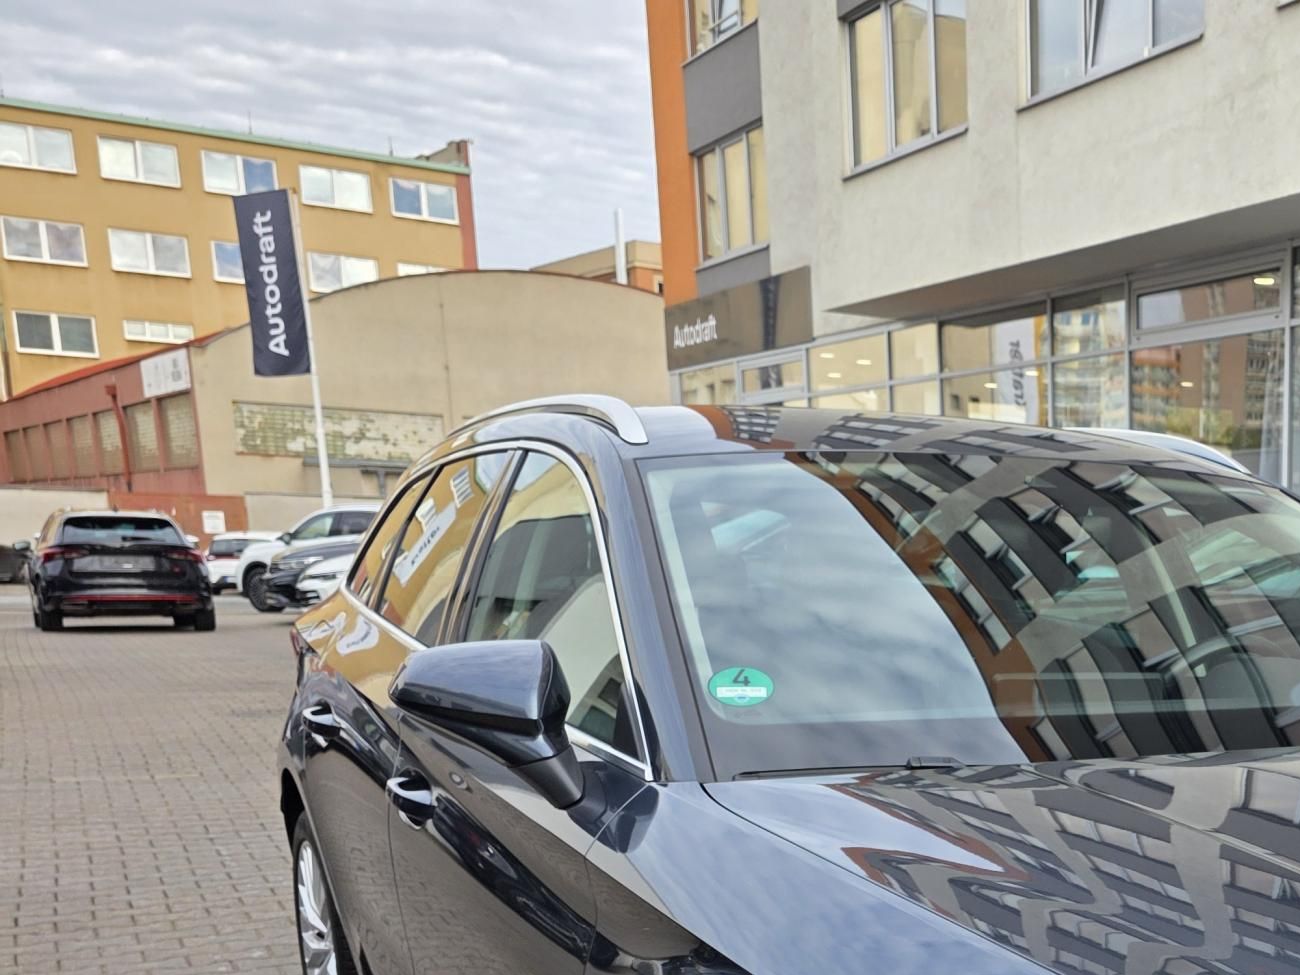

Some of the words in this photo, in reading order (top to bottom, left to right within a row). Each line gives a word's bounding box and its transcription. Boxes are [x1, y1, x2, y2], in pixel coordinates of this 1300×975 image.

[252, 209, 290, 357] Autodraft
[673, 313, 718, 349] Autodraft
[732, 668, 751, 687] 4
